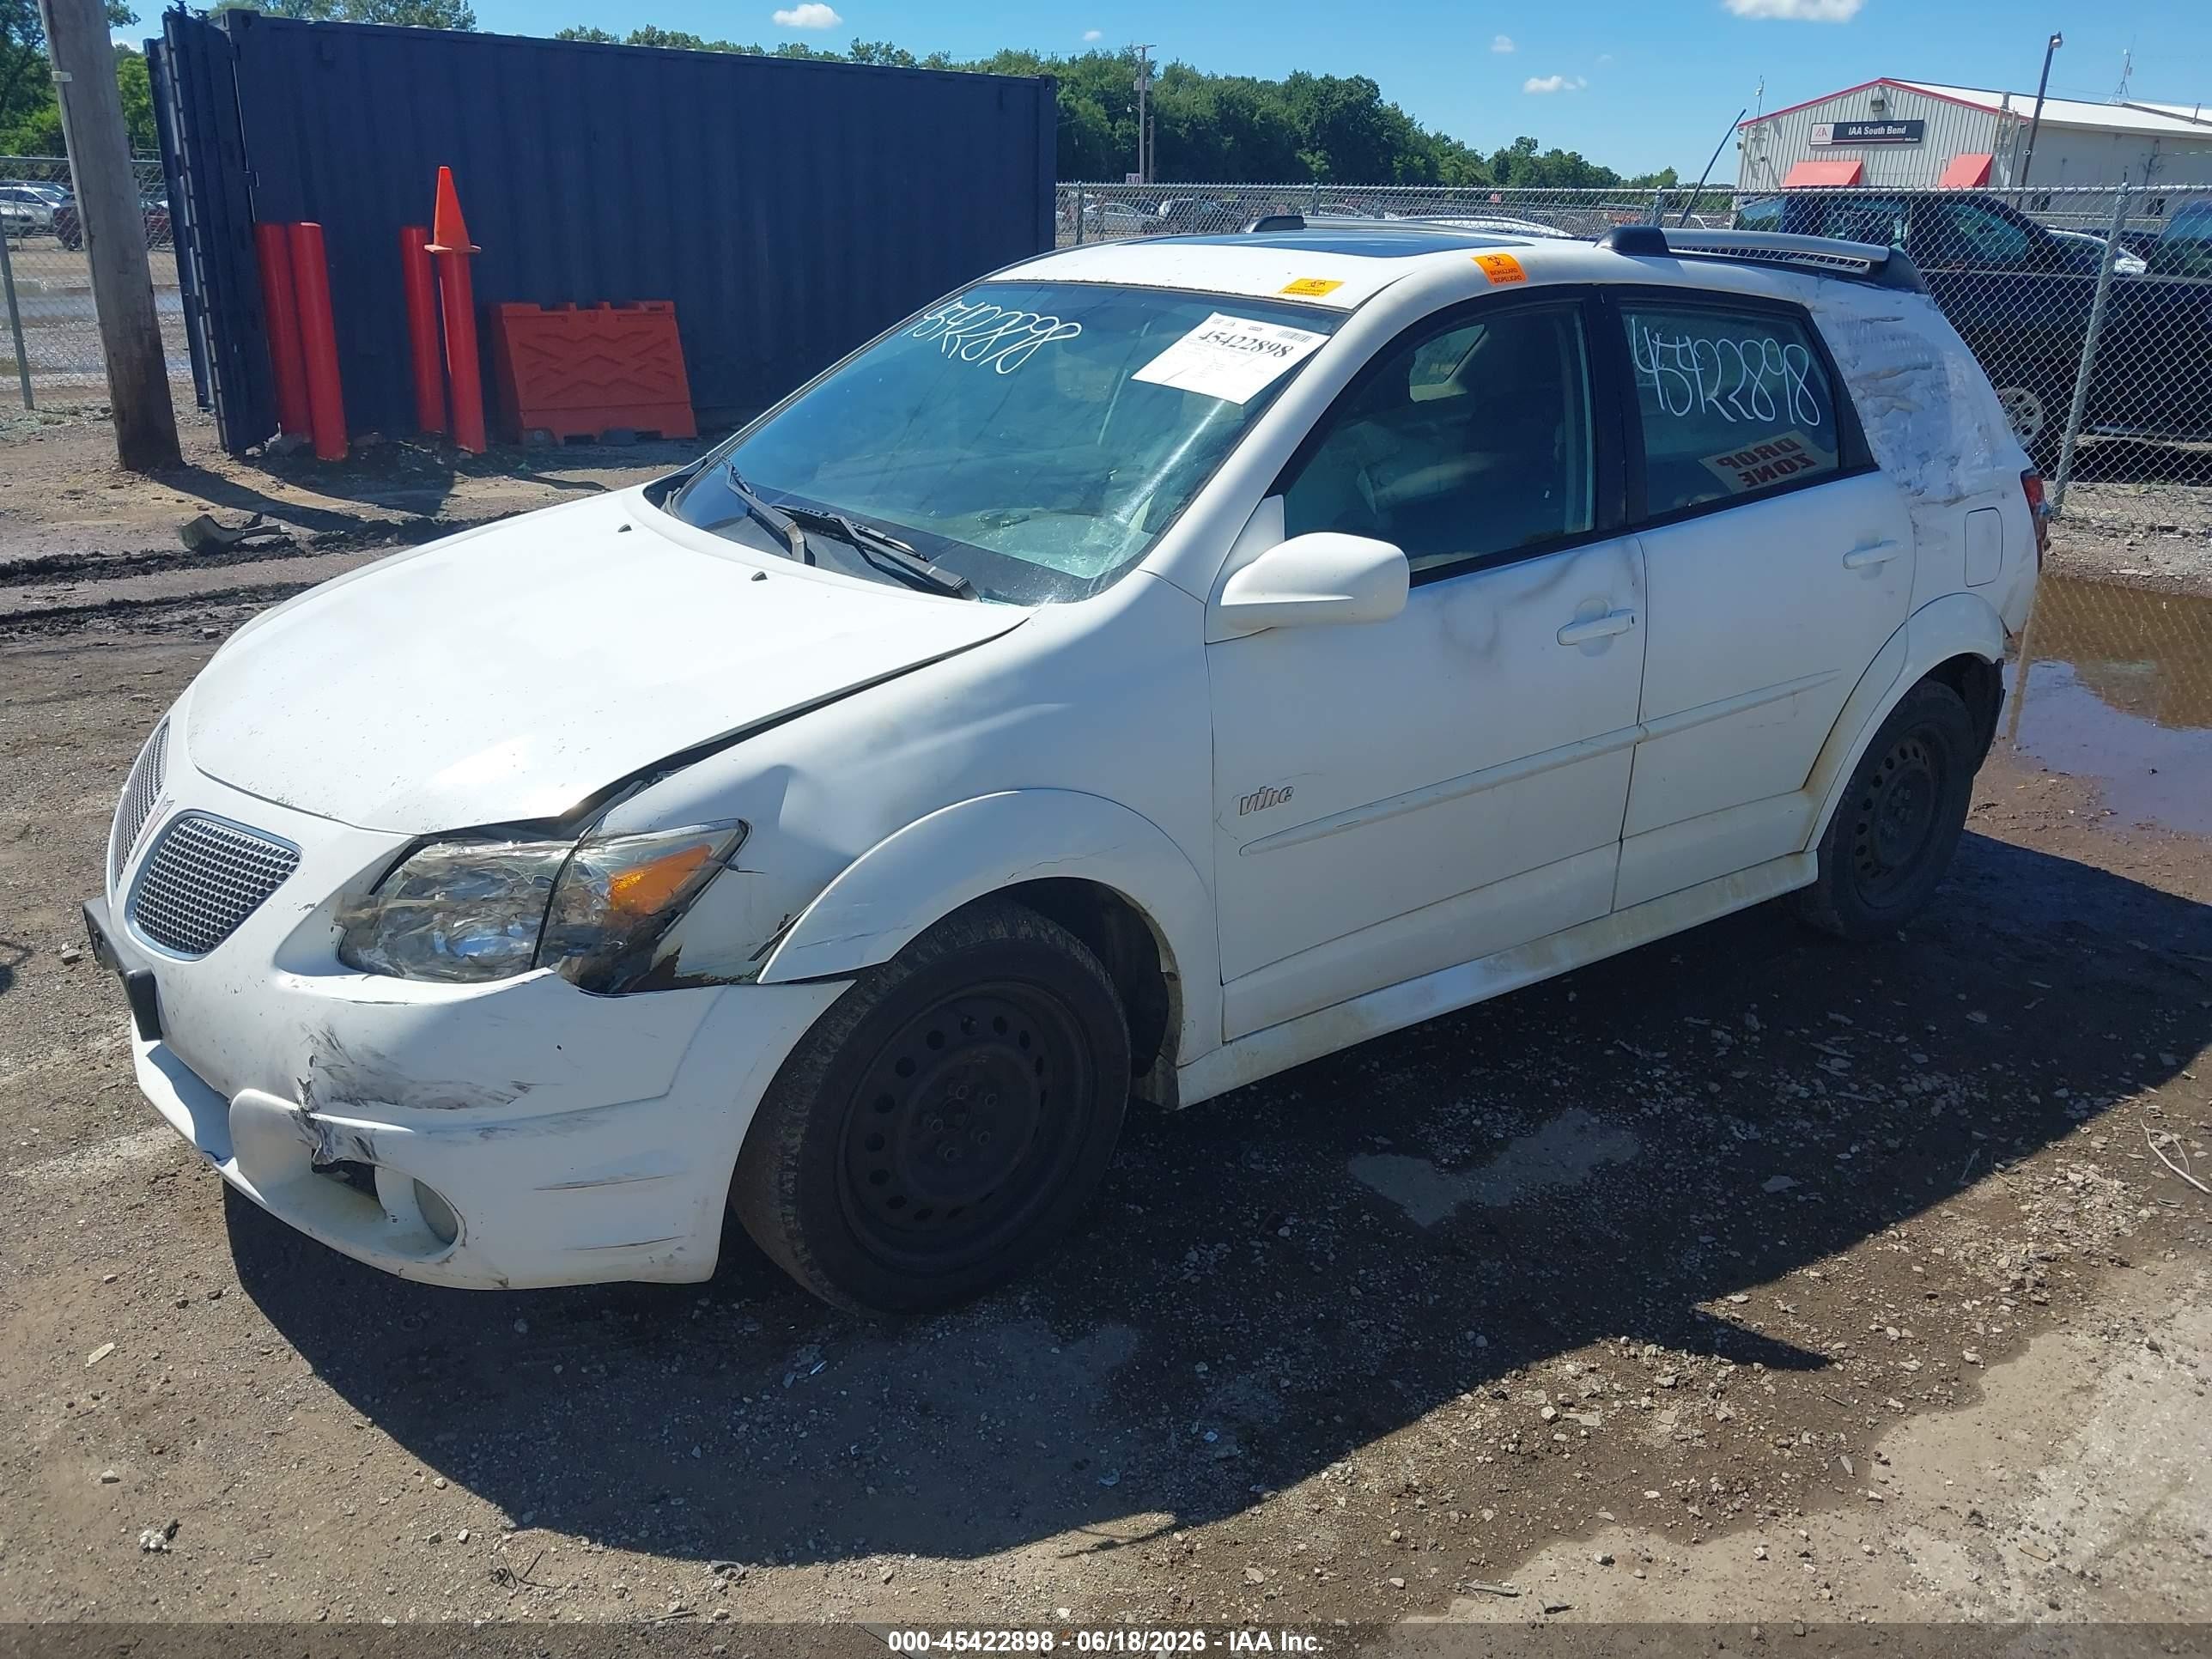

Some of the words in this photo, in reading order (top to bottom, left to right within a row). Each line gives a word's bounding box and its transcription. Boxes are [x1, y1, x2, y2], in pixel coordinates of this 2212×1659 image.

[1848, 126, 1863, 136] IAA
[1863, 126, 1885, 136] South
[1887, 125, 1907, 135] Bend
[1199, 330, 1294, 358] 45422898
[1632, 317, 1820, 426] 45422898
